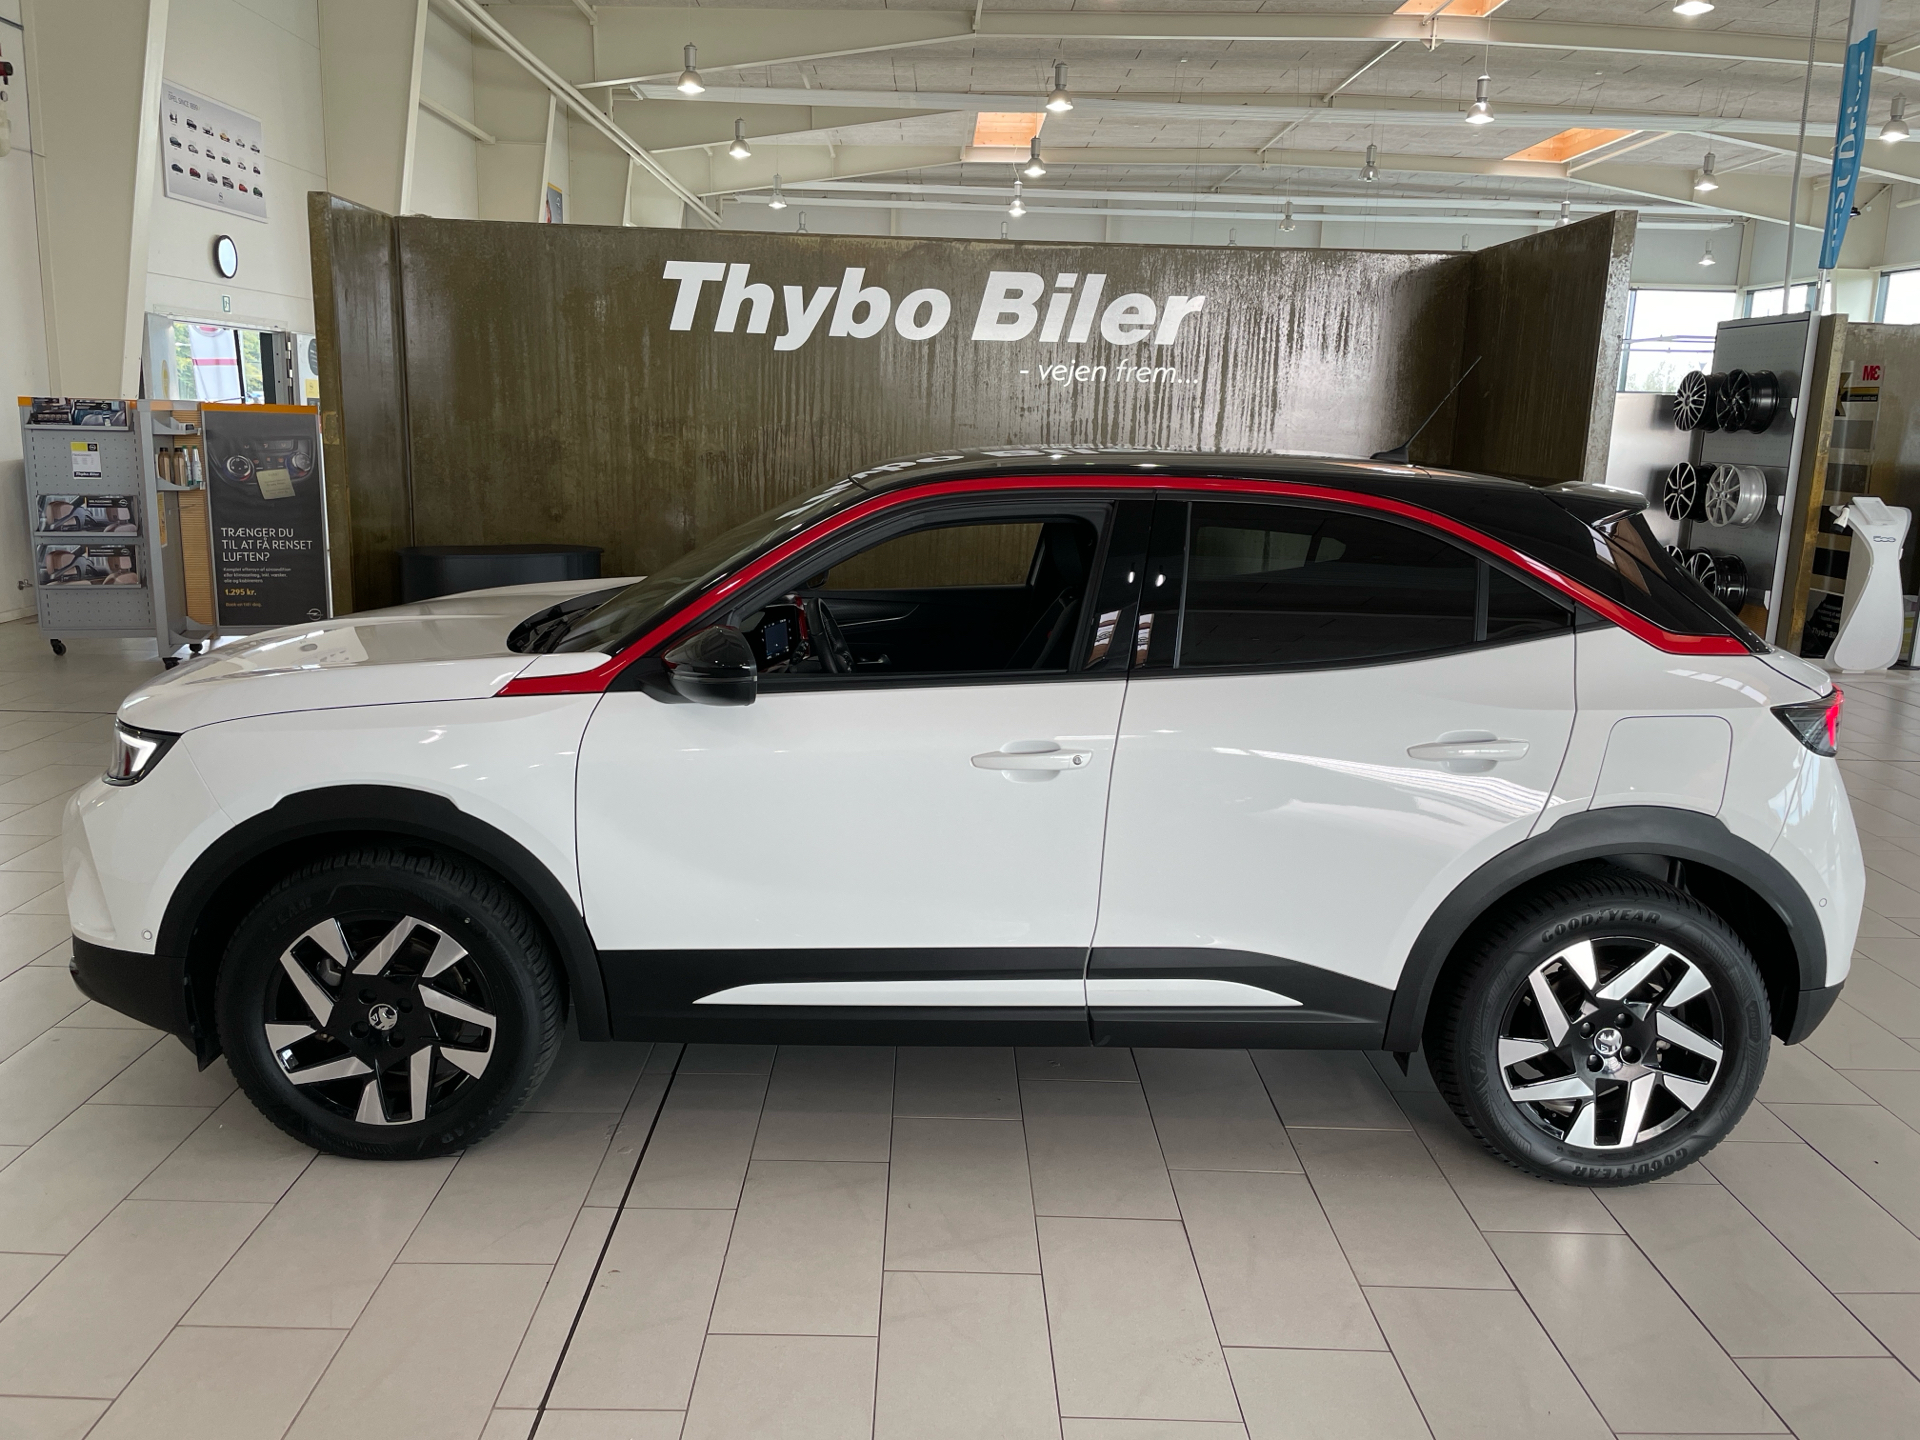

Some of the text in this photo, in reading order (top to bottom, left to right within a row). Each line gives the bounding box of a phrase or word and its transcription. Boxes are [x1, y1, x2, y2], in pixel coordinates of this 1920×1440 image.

[662, 260, 1207, 351] Thybo Biler
[1038, 358, 1107, 387] vejen
[1114, 357, 1199, 385] frem...
[221, 527, 294, 537] TRÆNGER DU
[222, 537, 313, 550] TIL AT FÅ RENSET
[222, 551, 270, 561] LUFTEN?
[246, 588, 257, 596] kr.
